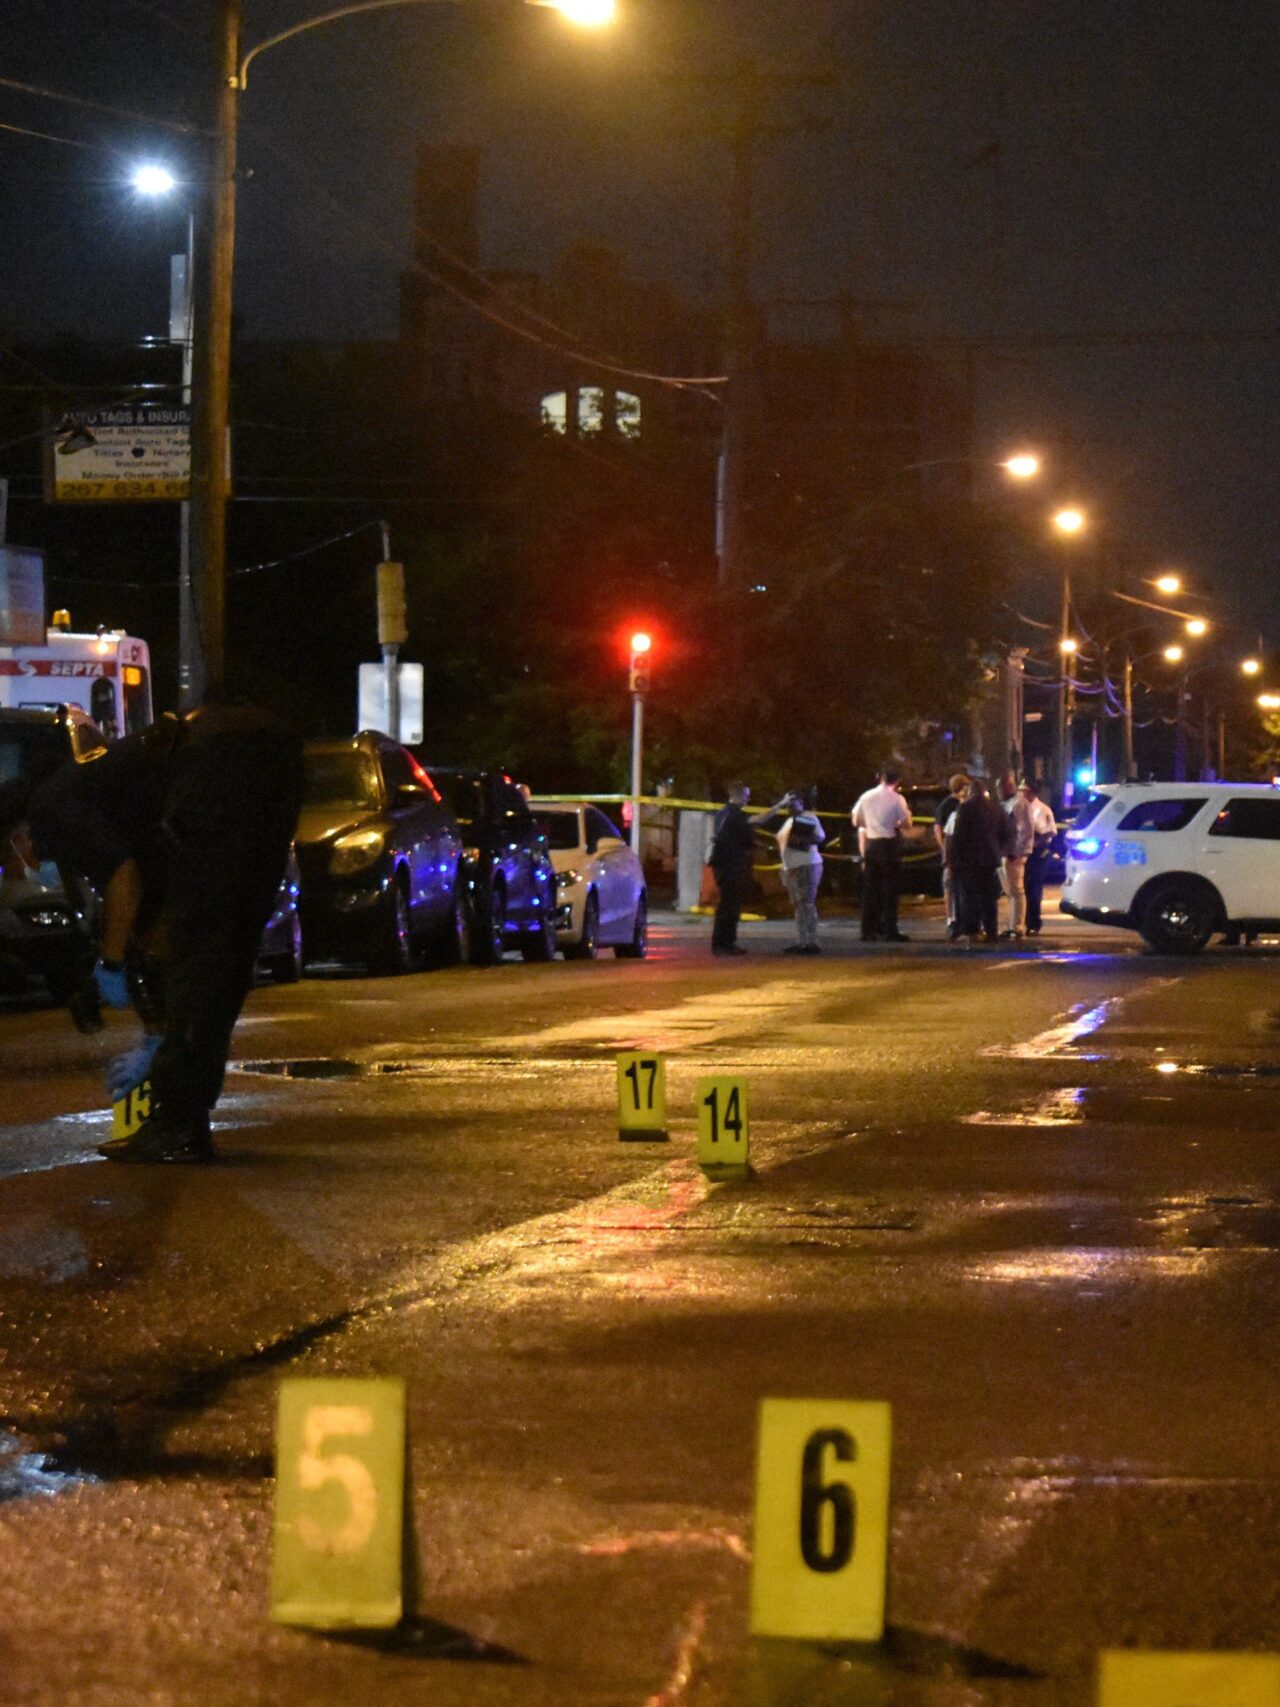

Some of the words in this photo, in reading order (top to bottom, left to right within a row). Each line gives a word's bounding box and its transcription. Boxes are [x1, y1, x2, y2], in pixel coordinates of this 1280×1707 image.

[101, 411, 133, 423] TAGS
[148, 410, 190, 423] INSUR
[62, 484, 105, 498] 267
[113, 482, 156, 496] 634
[51, 662, 104, 677] SEPTA
[625, 1060, 657, 1110] 17
[704, 1087, 742, 1143] 14
[298, 1406, 376, 1555] 5
[801, 1427, 857, 1572] 6
